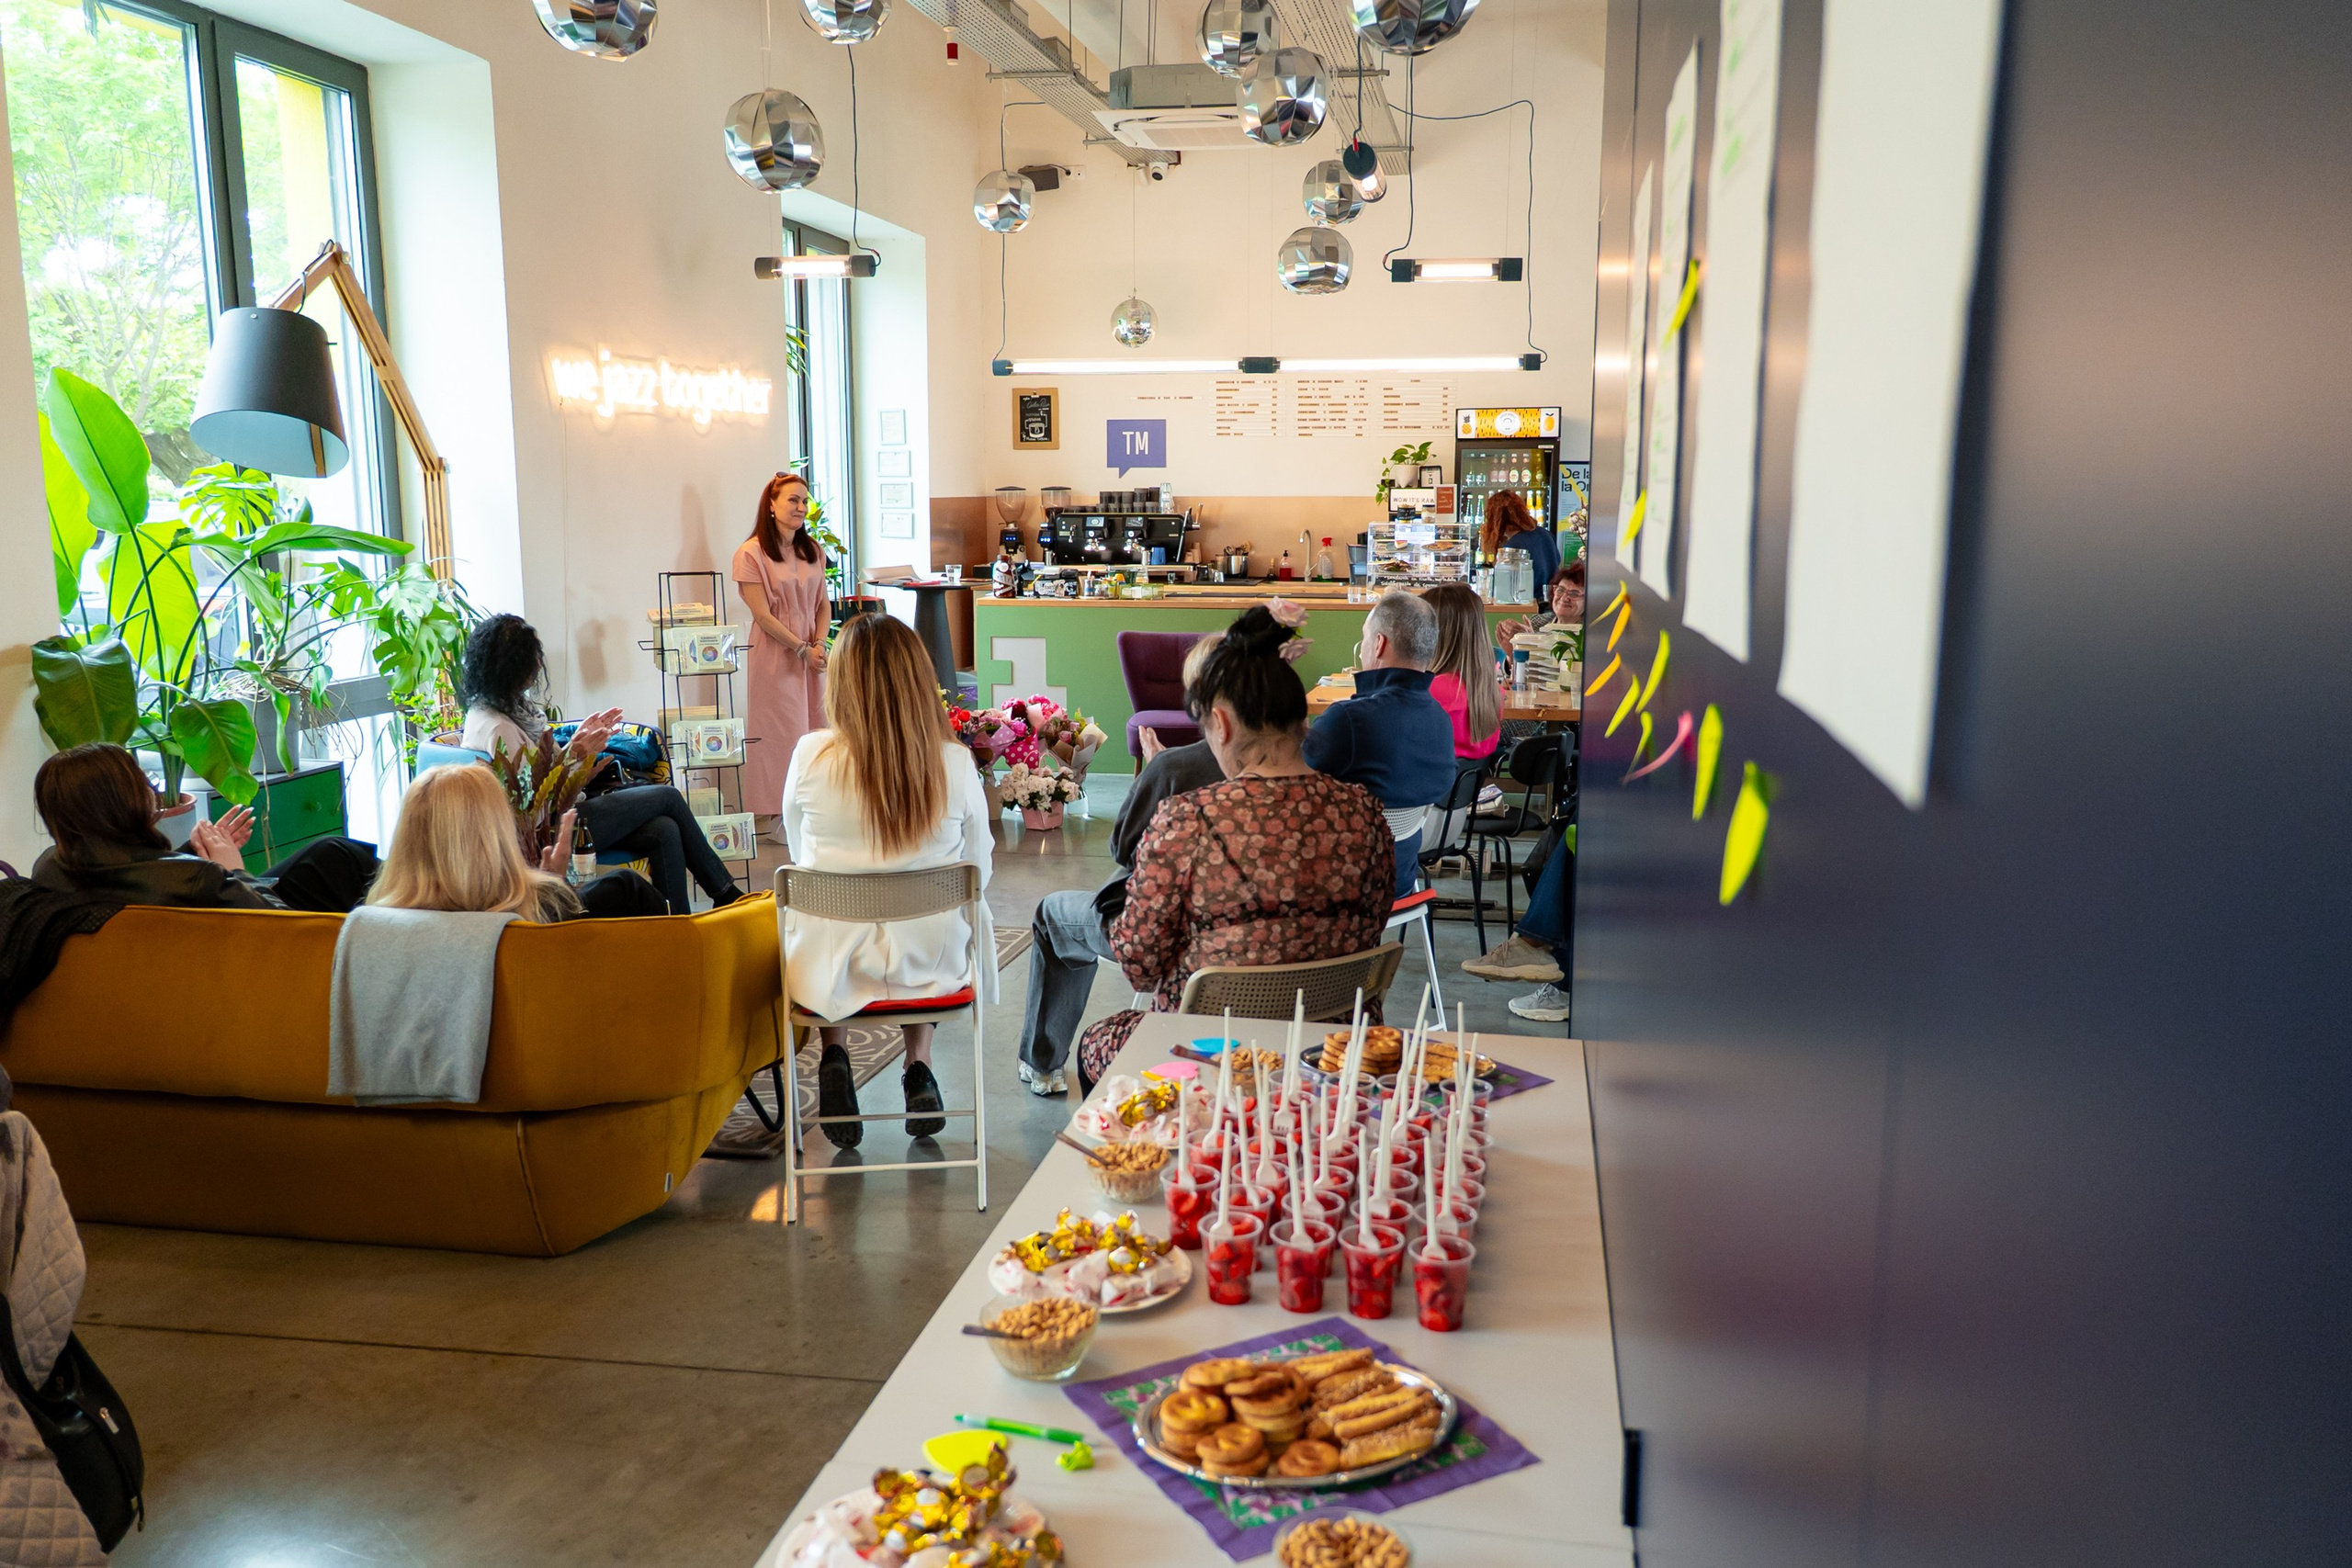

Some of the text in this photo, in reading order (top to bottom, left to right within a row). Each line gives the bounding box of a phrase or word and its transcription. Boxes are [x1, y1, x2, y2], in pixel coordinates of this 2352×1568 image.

[660, 358, 772, 425] together
[1122, 431, 1148, 455] TM
[1561, 480, 1572, 492] la
